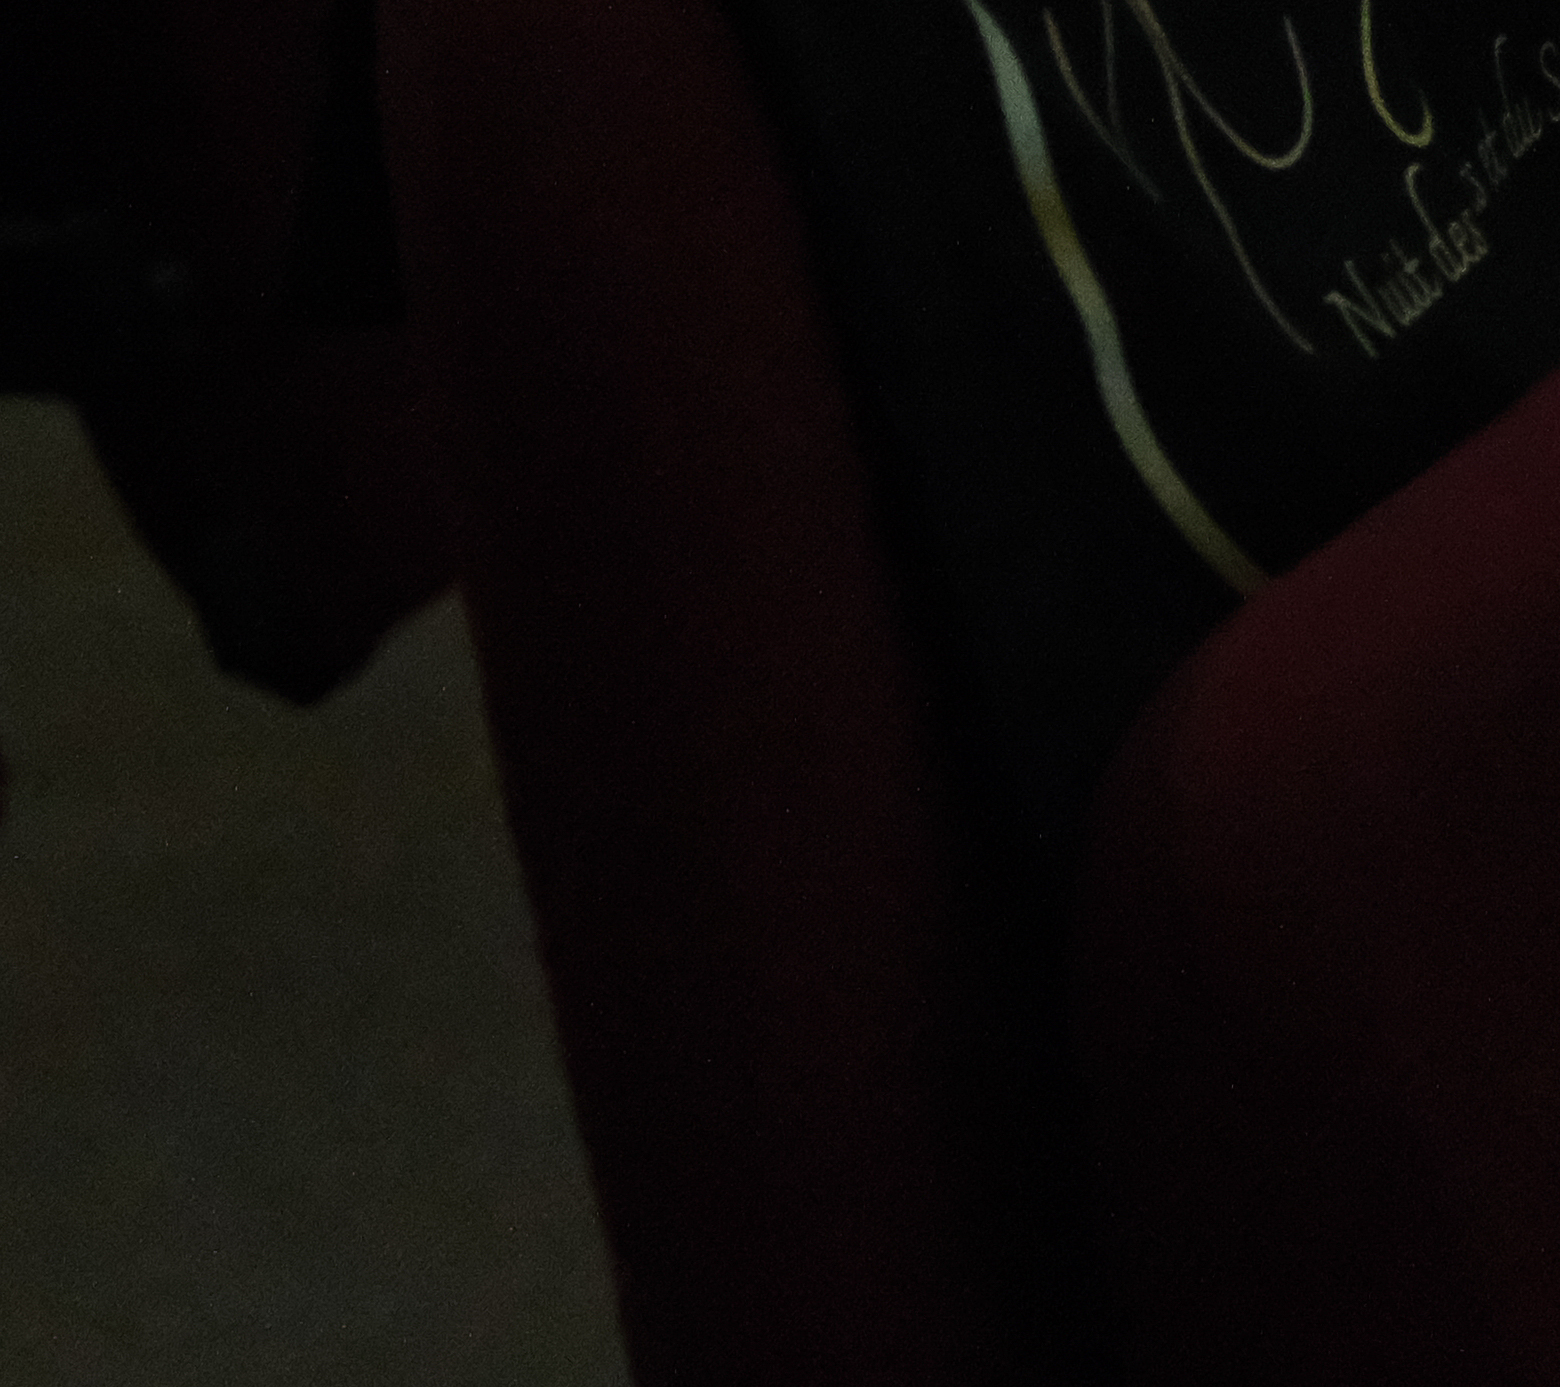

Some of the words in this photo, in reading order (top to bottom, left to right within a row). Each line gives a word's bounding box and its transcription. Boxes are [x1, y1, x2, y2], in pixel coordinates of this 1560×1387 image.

[1321, 235, 1446, 361] Nuit
[1402, 160, 1491, 285] des
[1492, 32, 1545, 162] du
